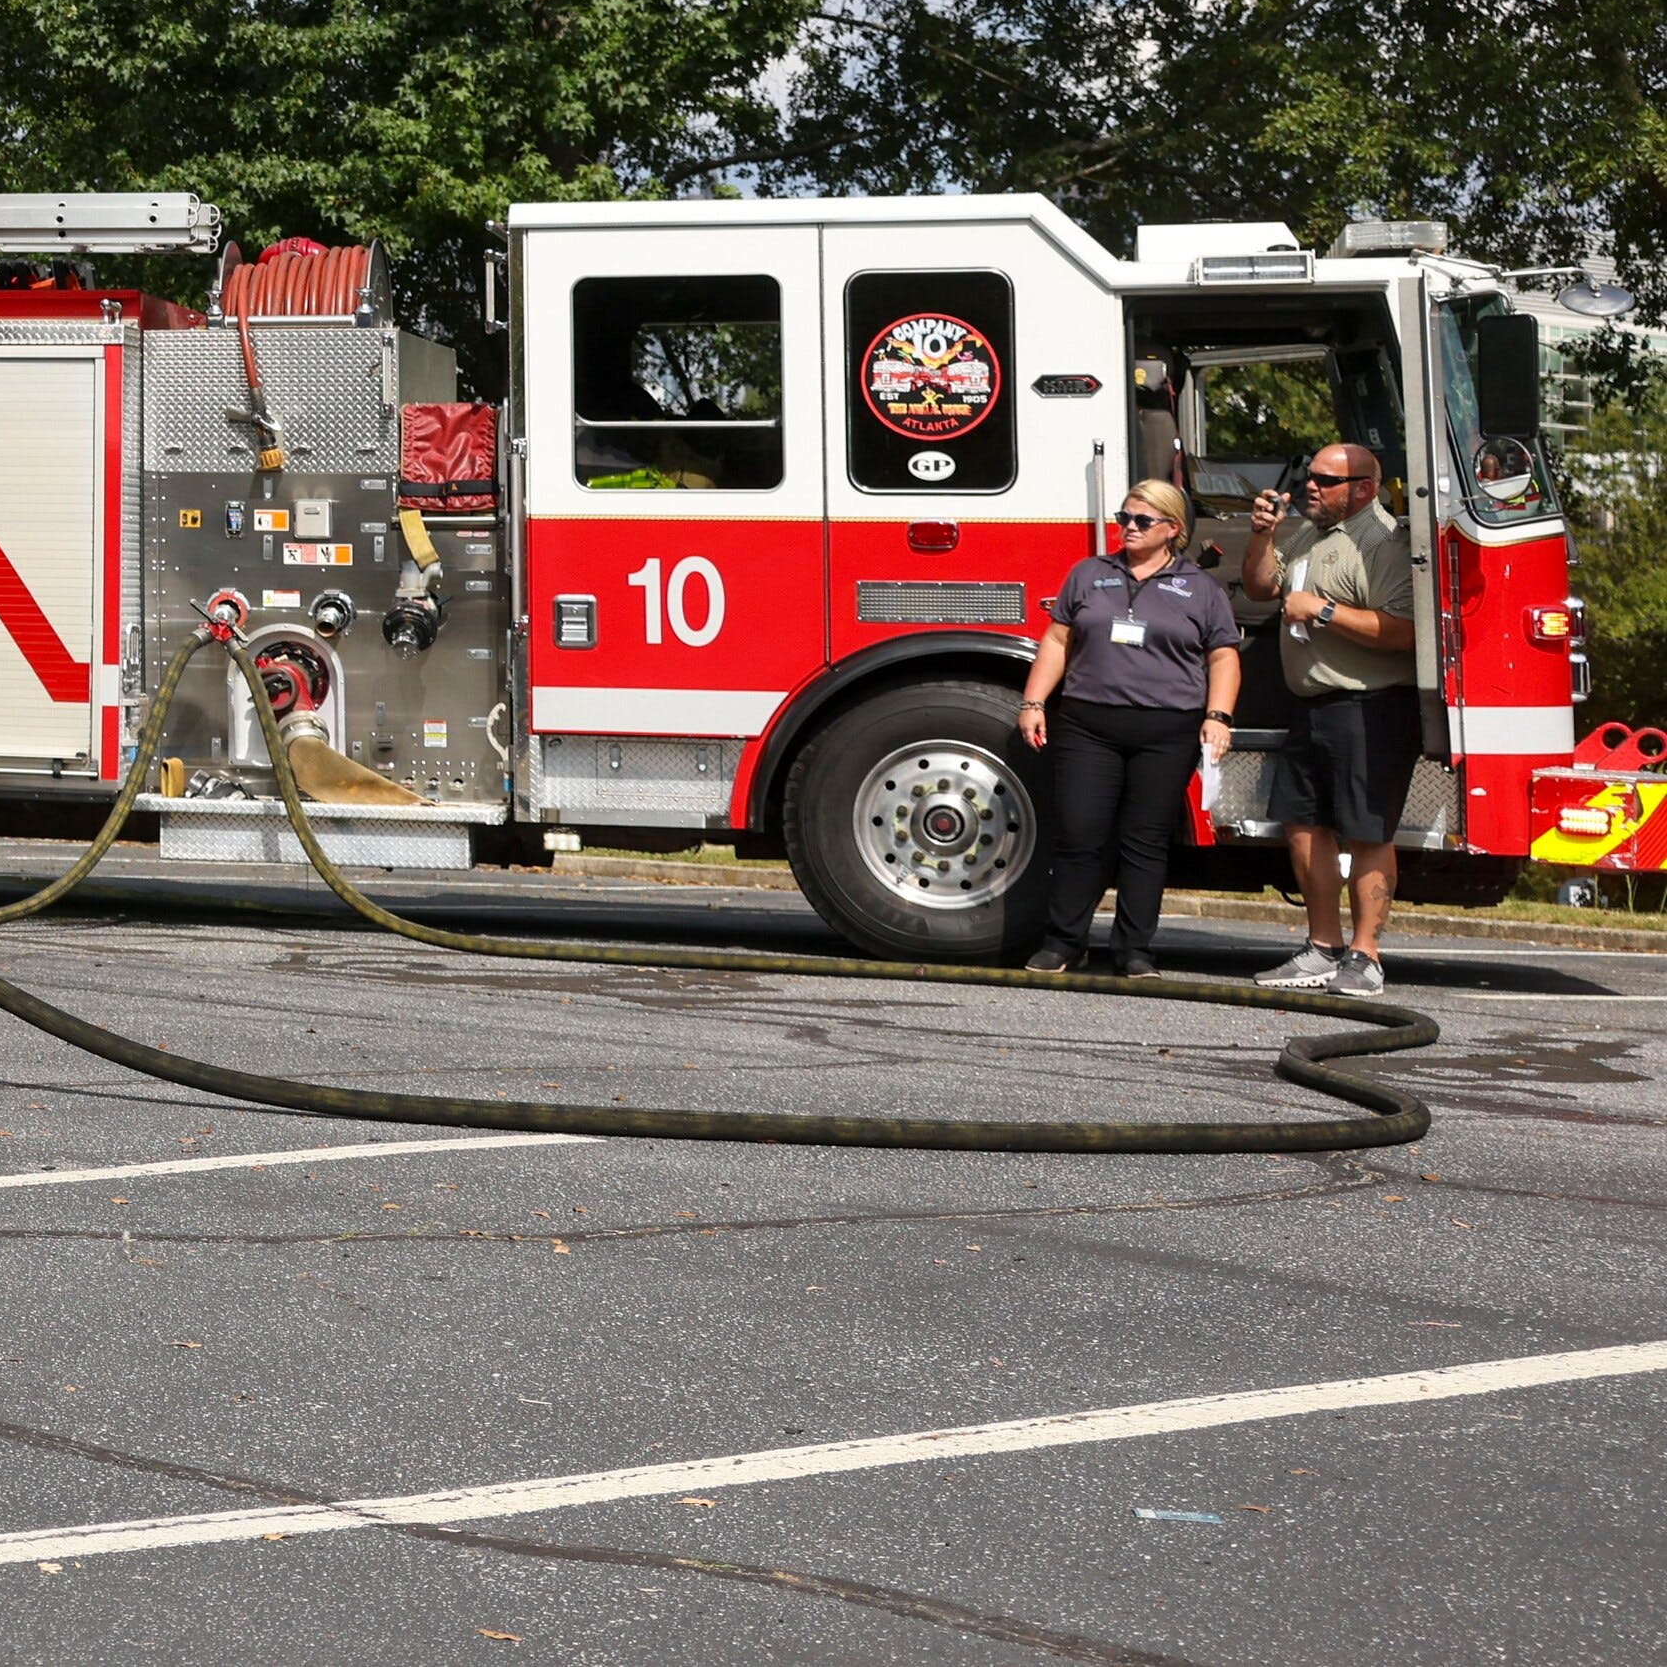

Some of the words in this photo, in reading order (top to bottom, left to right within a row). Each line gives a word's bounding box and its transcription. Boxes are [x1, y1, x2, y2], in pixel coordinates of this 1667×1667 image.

[892, 318, 968, 341] COMPANY
[912, 333, 947, 359] 10
[879, 393, 899, 401] EST
[902, 417, 959, 431] ATLANTA
[912, 459, 951, 472] GP
[627, 555, 726, 647] 10
